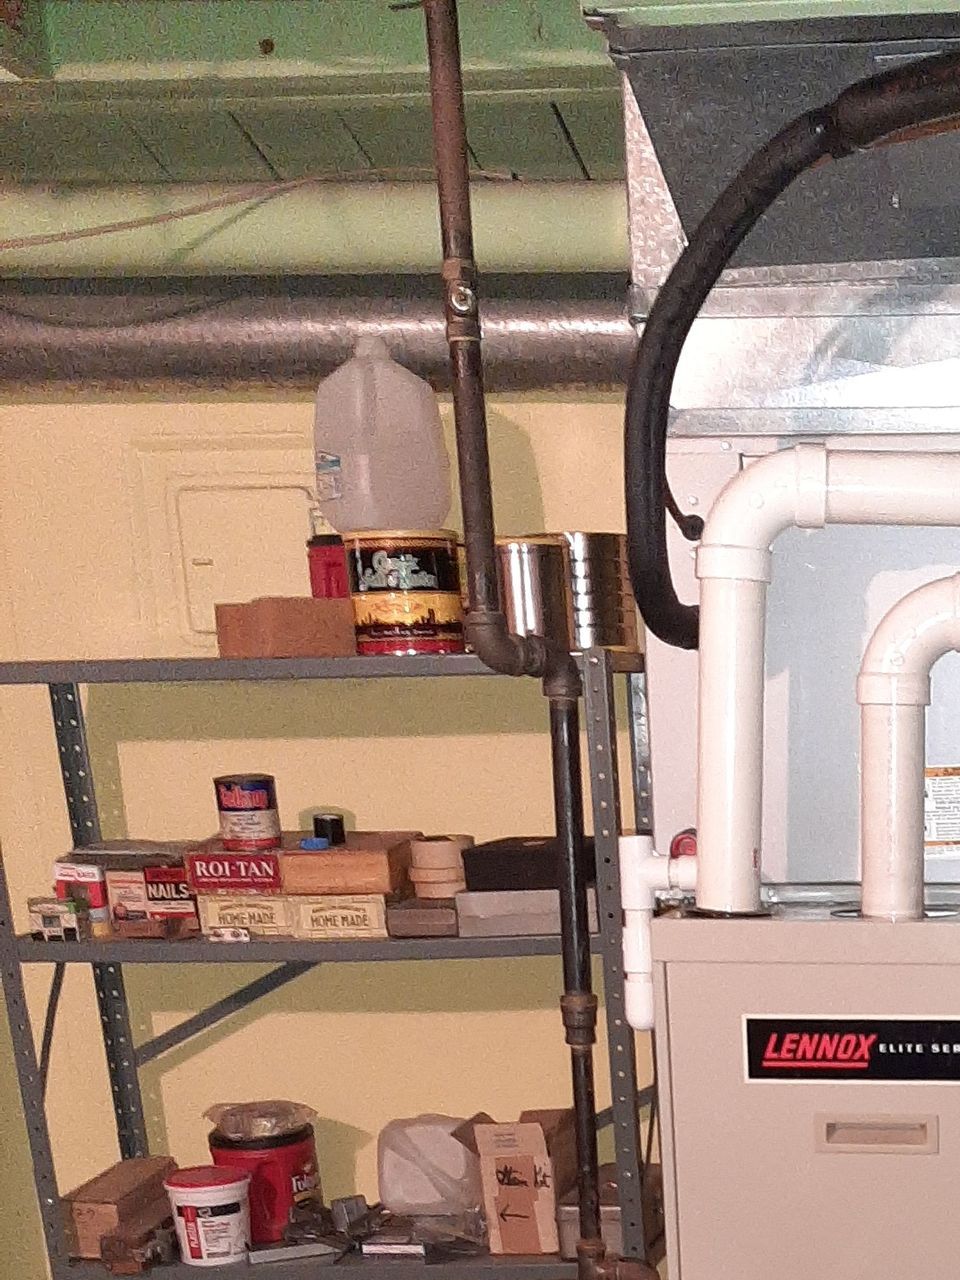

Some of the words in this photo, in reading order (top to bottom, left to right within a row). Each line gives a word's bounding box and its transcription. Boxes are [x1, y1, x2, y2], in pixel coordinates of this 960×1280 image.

[148, 883, 189, 899] NAILS
[217, 911, 247, 926] HOME
[249, 911, 276, 925] MADE
[310, 914, 338, 928] HOME
[341, 914, 369, 927] MADE
[764, 1032, 878, 1060] LENNOX
[879, 1043, 924, 1054] ELITE
